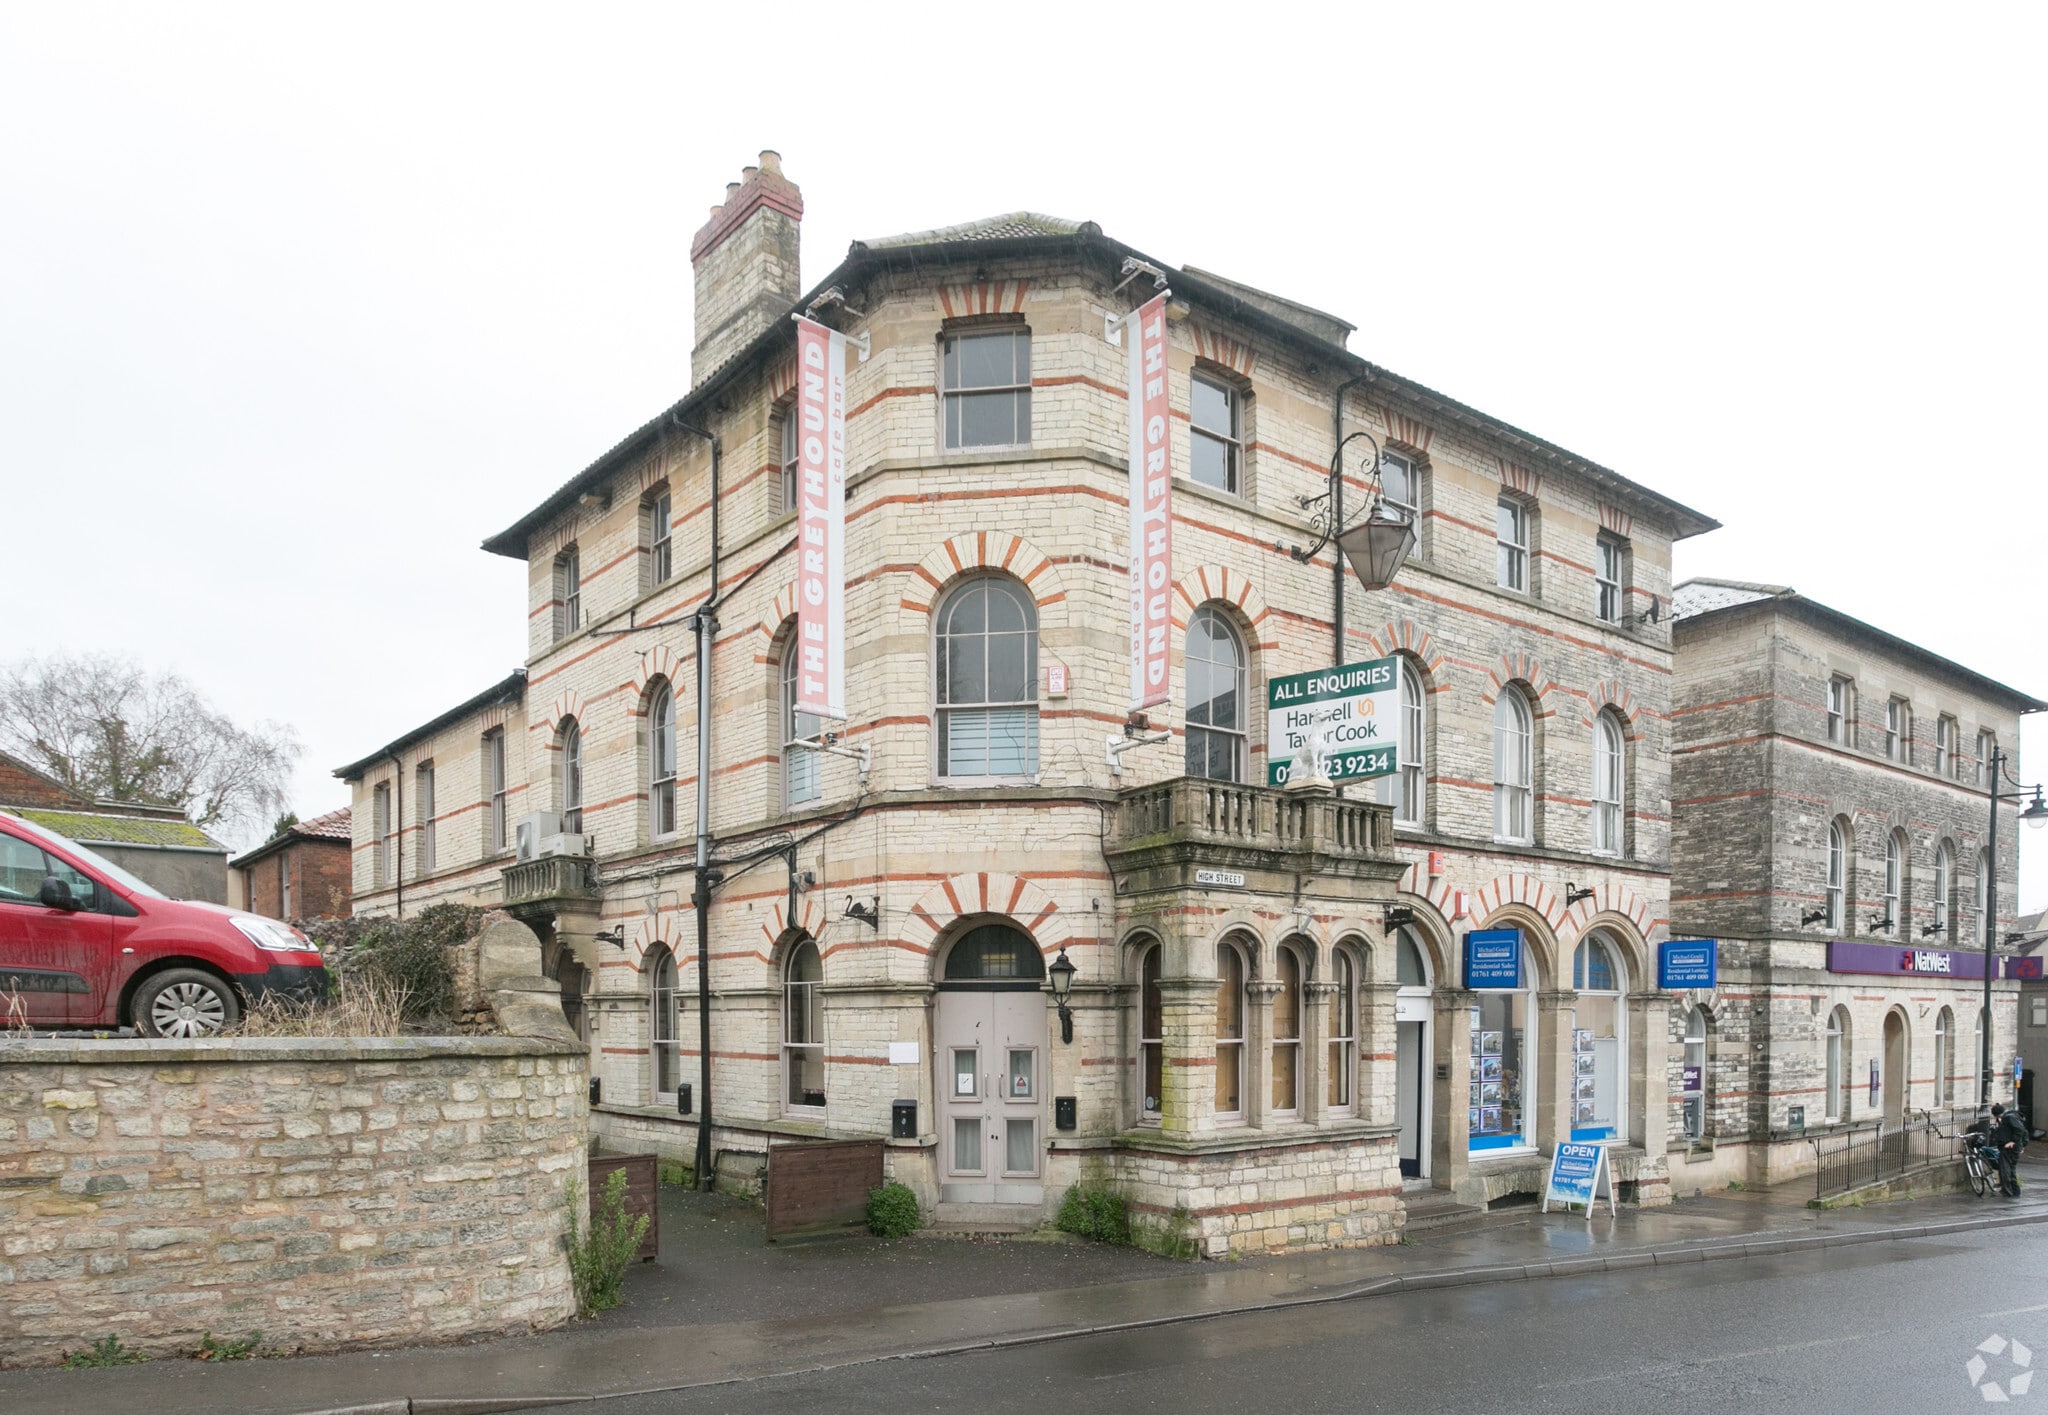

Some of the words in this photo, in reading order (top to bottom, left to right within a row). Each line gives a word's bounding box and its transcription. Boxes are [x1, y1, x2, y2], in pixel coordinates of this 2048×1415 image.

[1144, 315, 1164, 401] THE
[832, 376, 842, 420] bar
[804, 341, 829, 606] GREYHOUND
[1144, 415, 1166, 686] GREYHOUND
[804, 620, 824, 696] THE
[1132, 622, 1141, 666] bar
[1274, 682, 1303, 701] ALL
[1307, 666, 1391, 695] ENQUIRIES
[1335, 720, 1378, 742] Cook
[1346, 752, 1389, 774] 9234
[1198, 871, 1213, 881] HIGH
[1216, 873, 1241, 884] STREET
[1471, 970, 1490, 978] 01761
[1914, 950, 1951, 972] NatWest
[1562, 1145, 1596, 1157] OPEN
